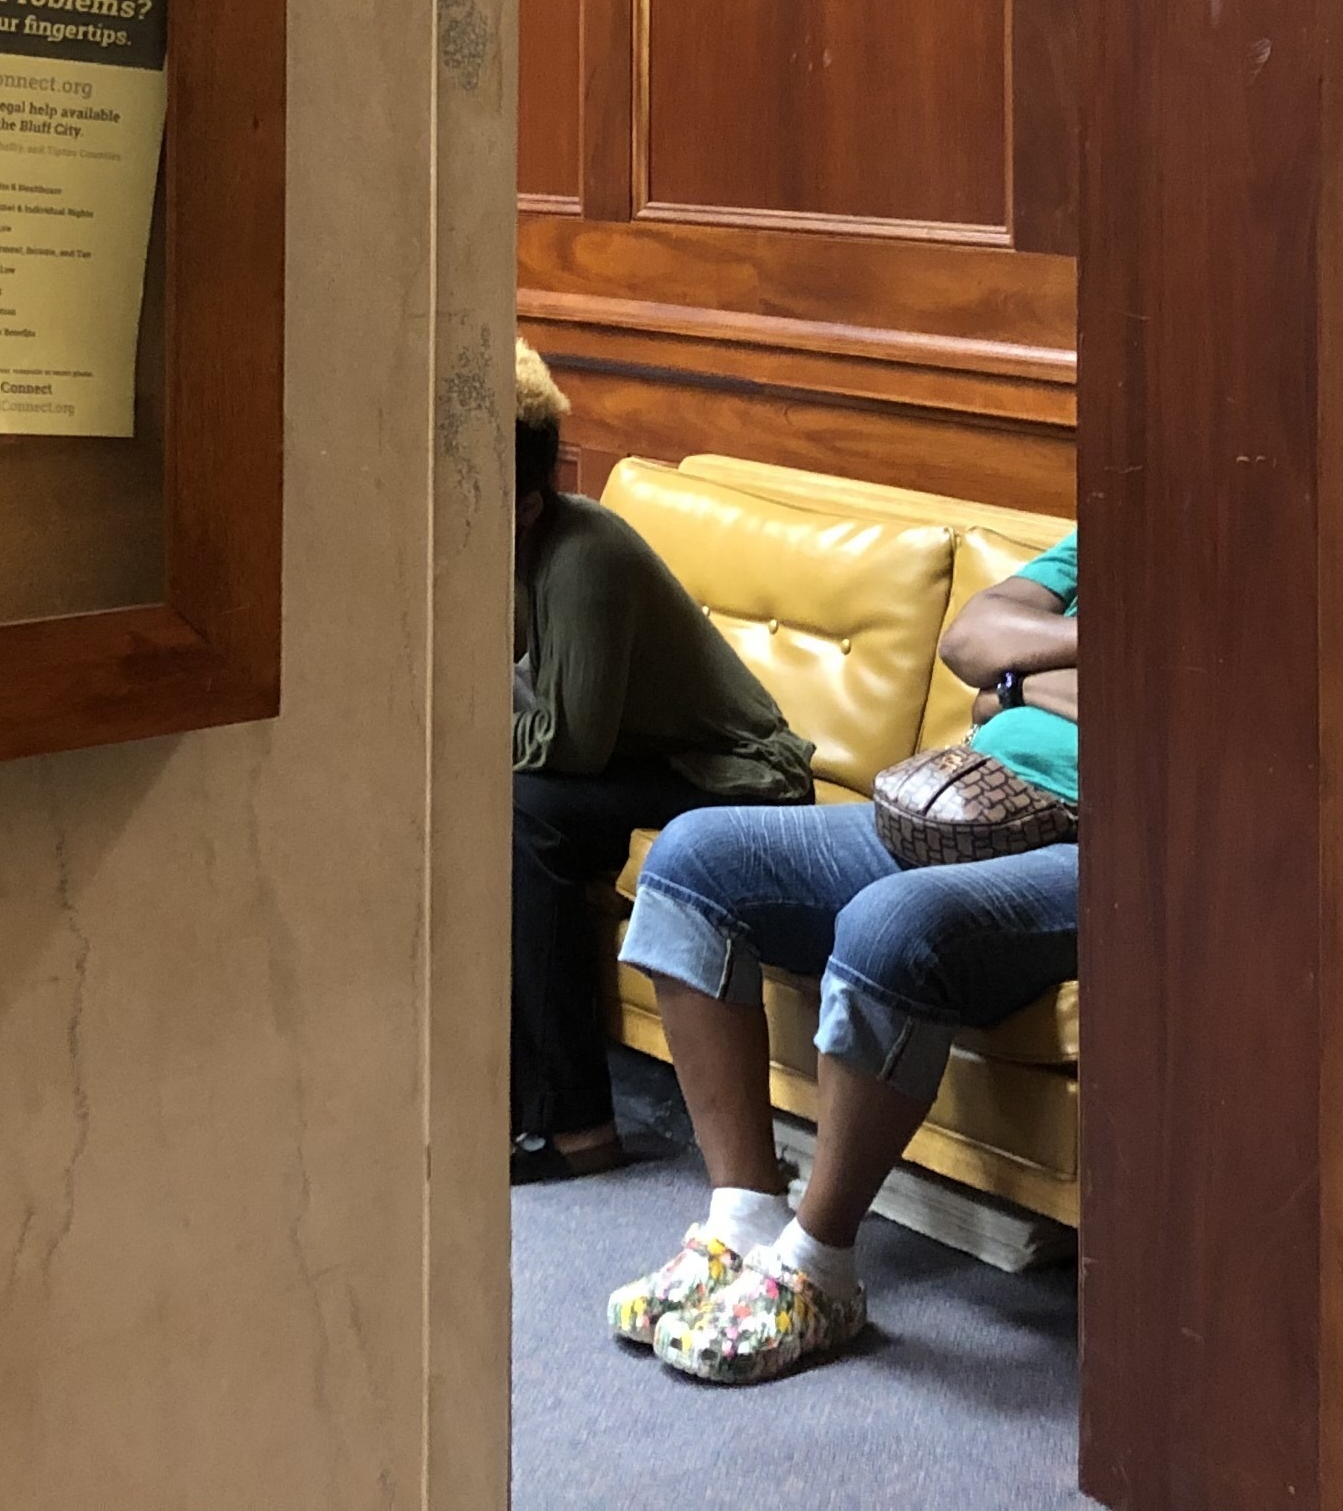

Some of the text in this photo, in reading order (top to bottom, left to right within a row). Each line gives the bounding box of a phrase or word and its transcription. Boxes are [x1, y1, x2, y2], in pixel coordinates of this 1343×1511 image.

[23, 15, 132, 47] fingertips.
[29, 101, 57, 120] help
[61, 104, 121, 122] available
[19, 119, 51, 134] Bluff
[54, 122, 83, 140] City.
[0, 380, 53, 394] Connect
